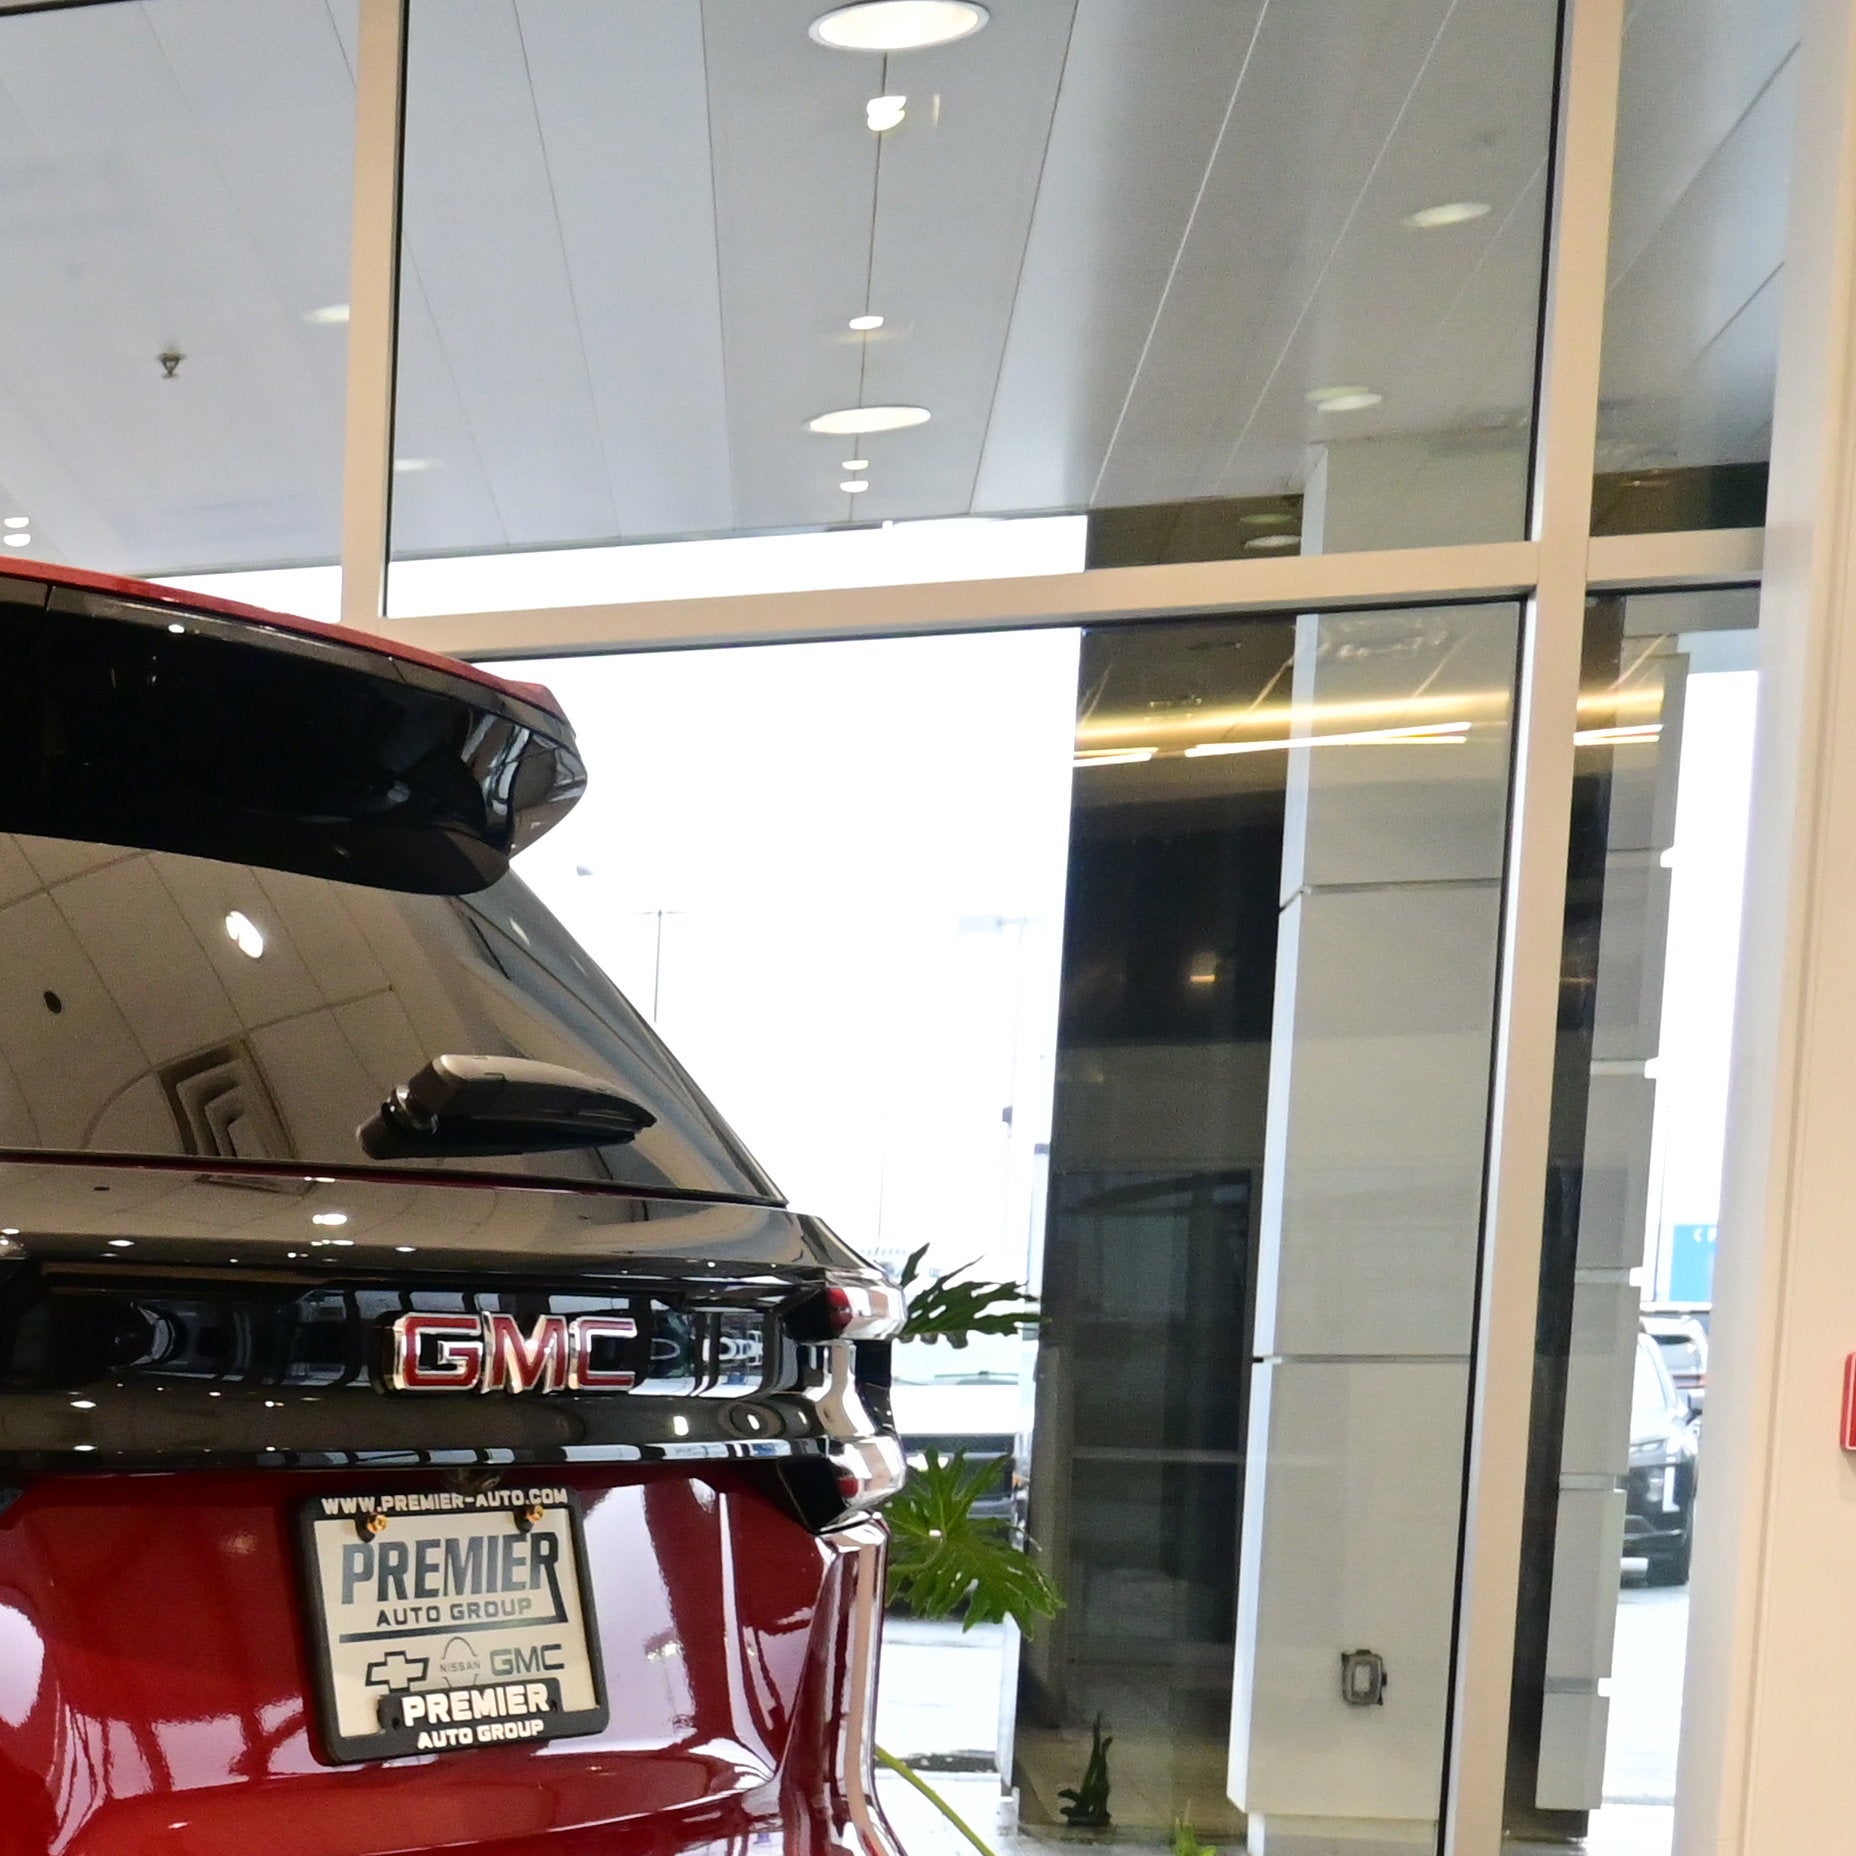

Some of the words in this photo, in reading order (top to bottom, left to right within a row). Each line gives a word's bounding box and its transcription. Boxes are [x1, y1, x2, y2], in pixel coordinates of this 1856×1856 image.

[393, 1311, 638, 1393] GMC
[321, 1489, 568, 1515] WWW.PREMIER-AUTO.COM
[341, 1531, 564, 1607] PREMIER
[376, 1605, 441, 1627] AUTO
[450, 1597, 532, 1621] GROUP
[439, 1659, 481, 1674] NISSAN
[490, 1643, 565, 1677] GMC
[401, 1683, 550, 1728] PREMIER
[417, 1725, 472, 1750] AUTO
[476, 1719, 544, 1744] GROUP
